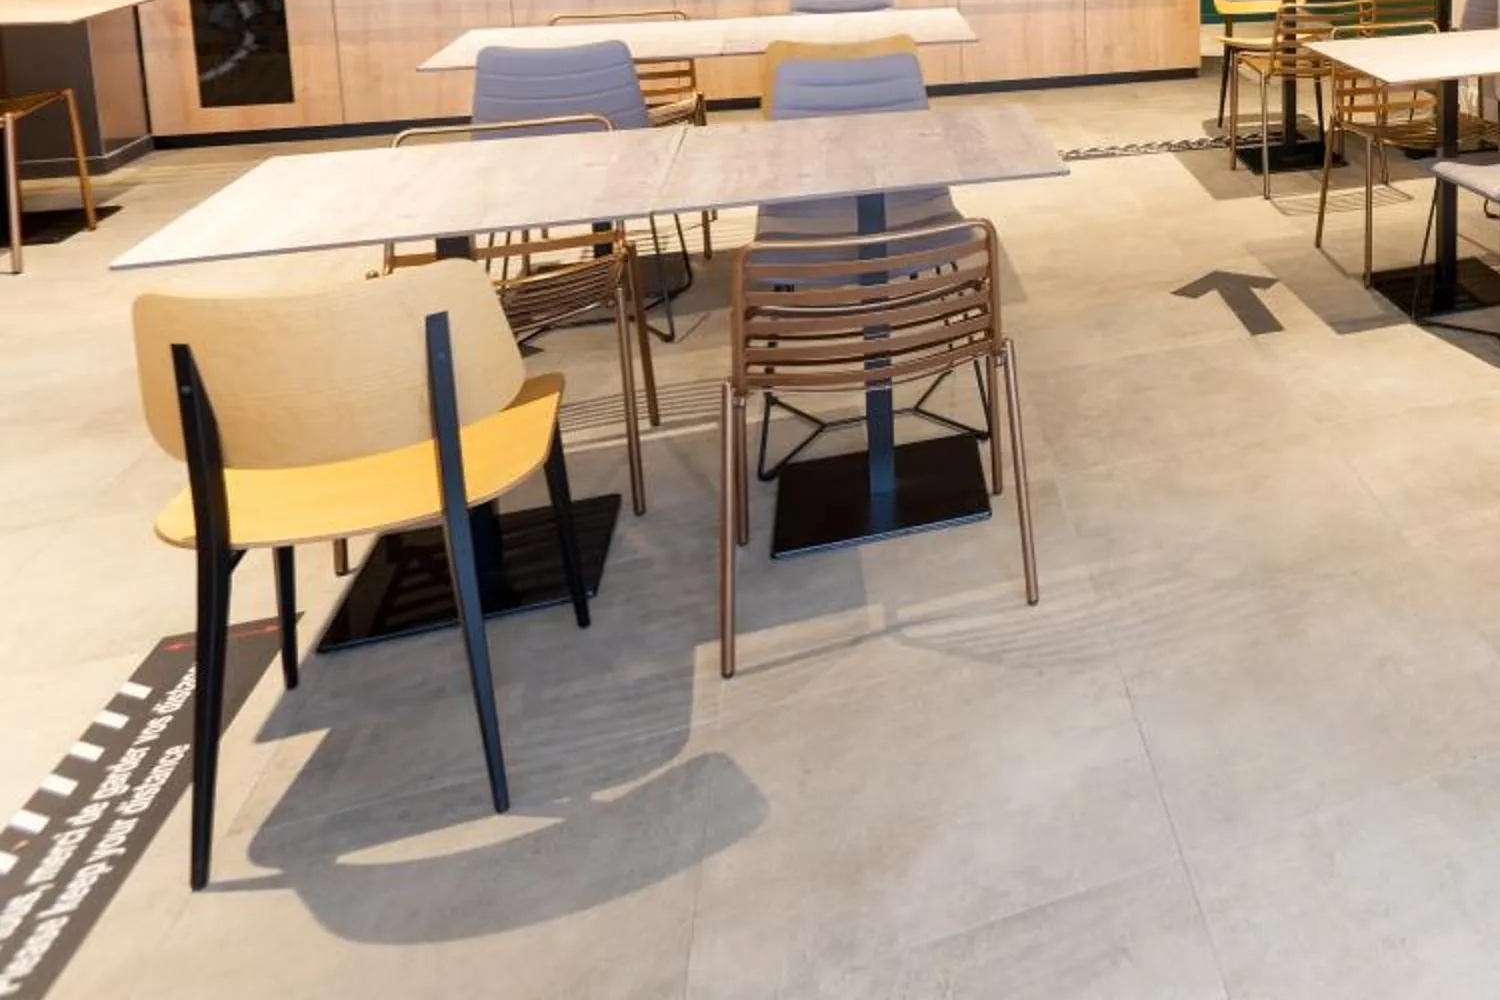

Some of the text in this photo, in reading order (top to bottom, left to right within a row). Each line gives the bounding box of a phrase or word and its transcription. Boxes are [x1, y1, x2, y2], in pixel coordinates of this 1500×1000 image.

[24, 826, 92, 886] merci
[65, 801, 110, 827] de
[92, 746, 150, 801] garder
[132, 715, 174, 745] vos
[36, 861, 113, 919] keep
[85, 818, 139, 863] your
[115, 743, 190, 815] distance
